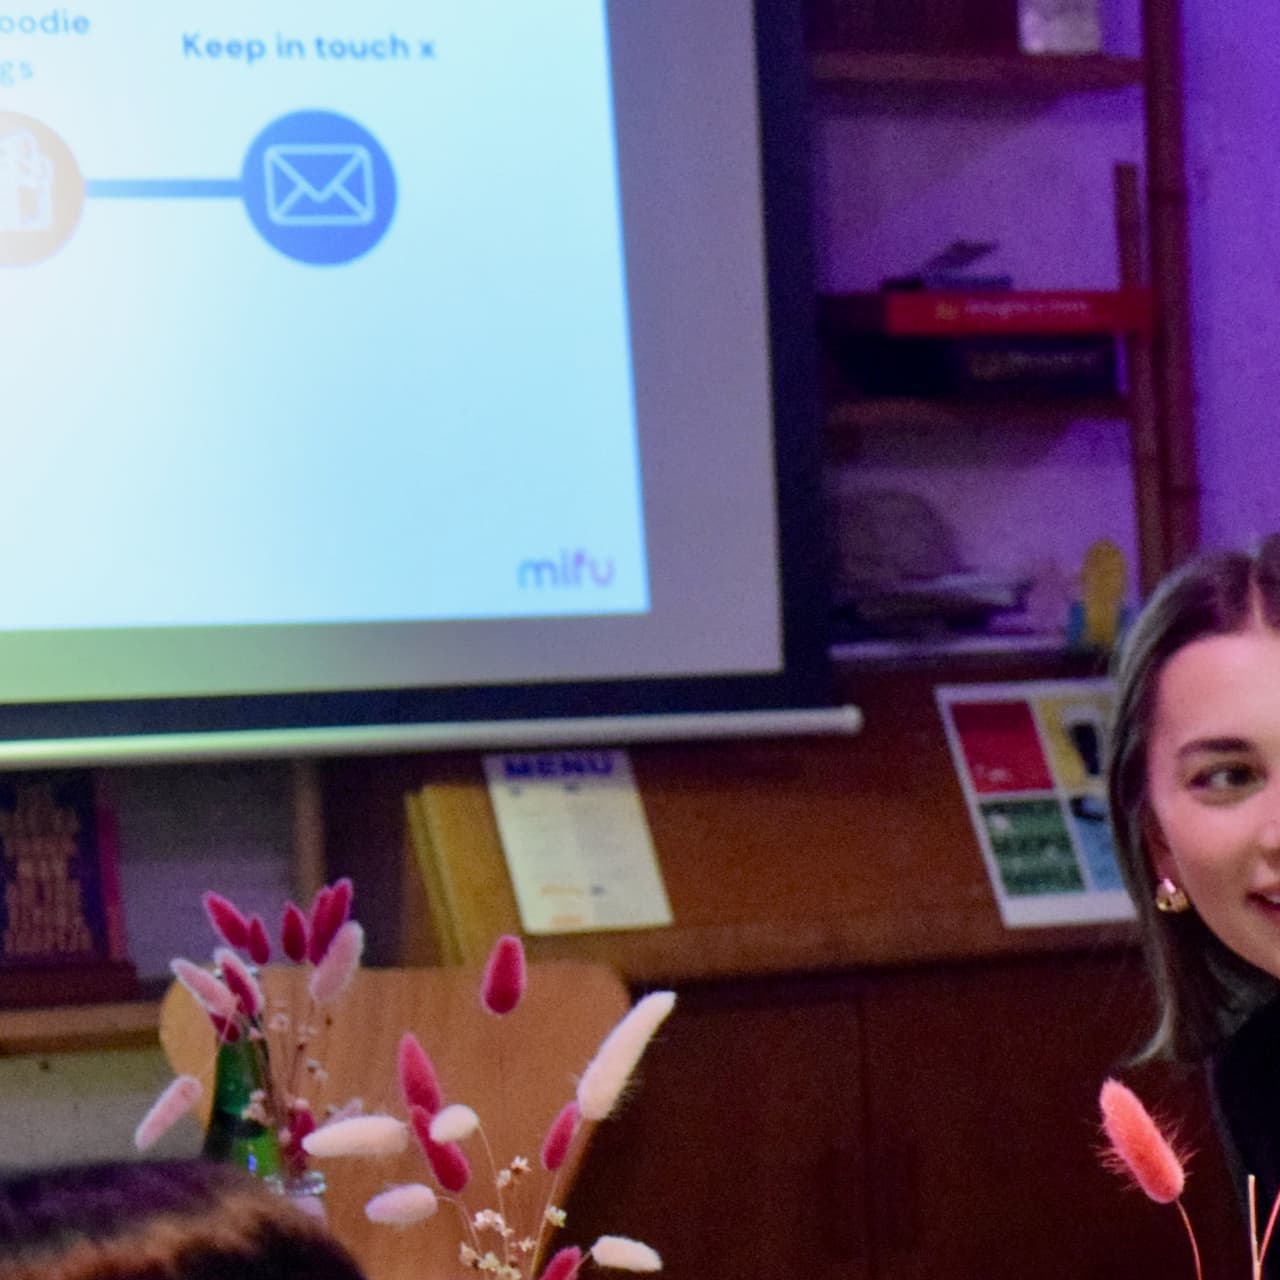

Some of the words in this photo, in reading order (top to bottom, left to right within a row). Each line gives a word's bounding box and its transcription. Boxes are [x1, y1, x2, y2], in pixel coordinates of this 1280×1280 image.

[182, 32, 266, 64] Keep
[276, 32, 304, 58] in
[315, 34, 409, 60] touch
[419, 39, 436, 58] x
[517, 547, 617, 588] mifu
[504, 756, 614, 779] MENU
